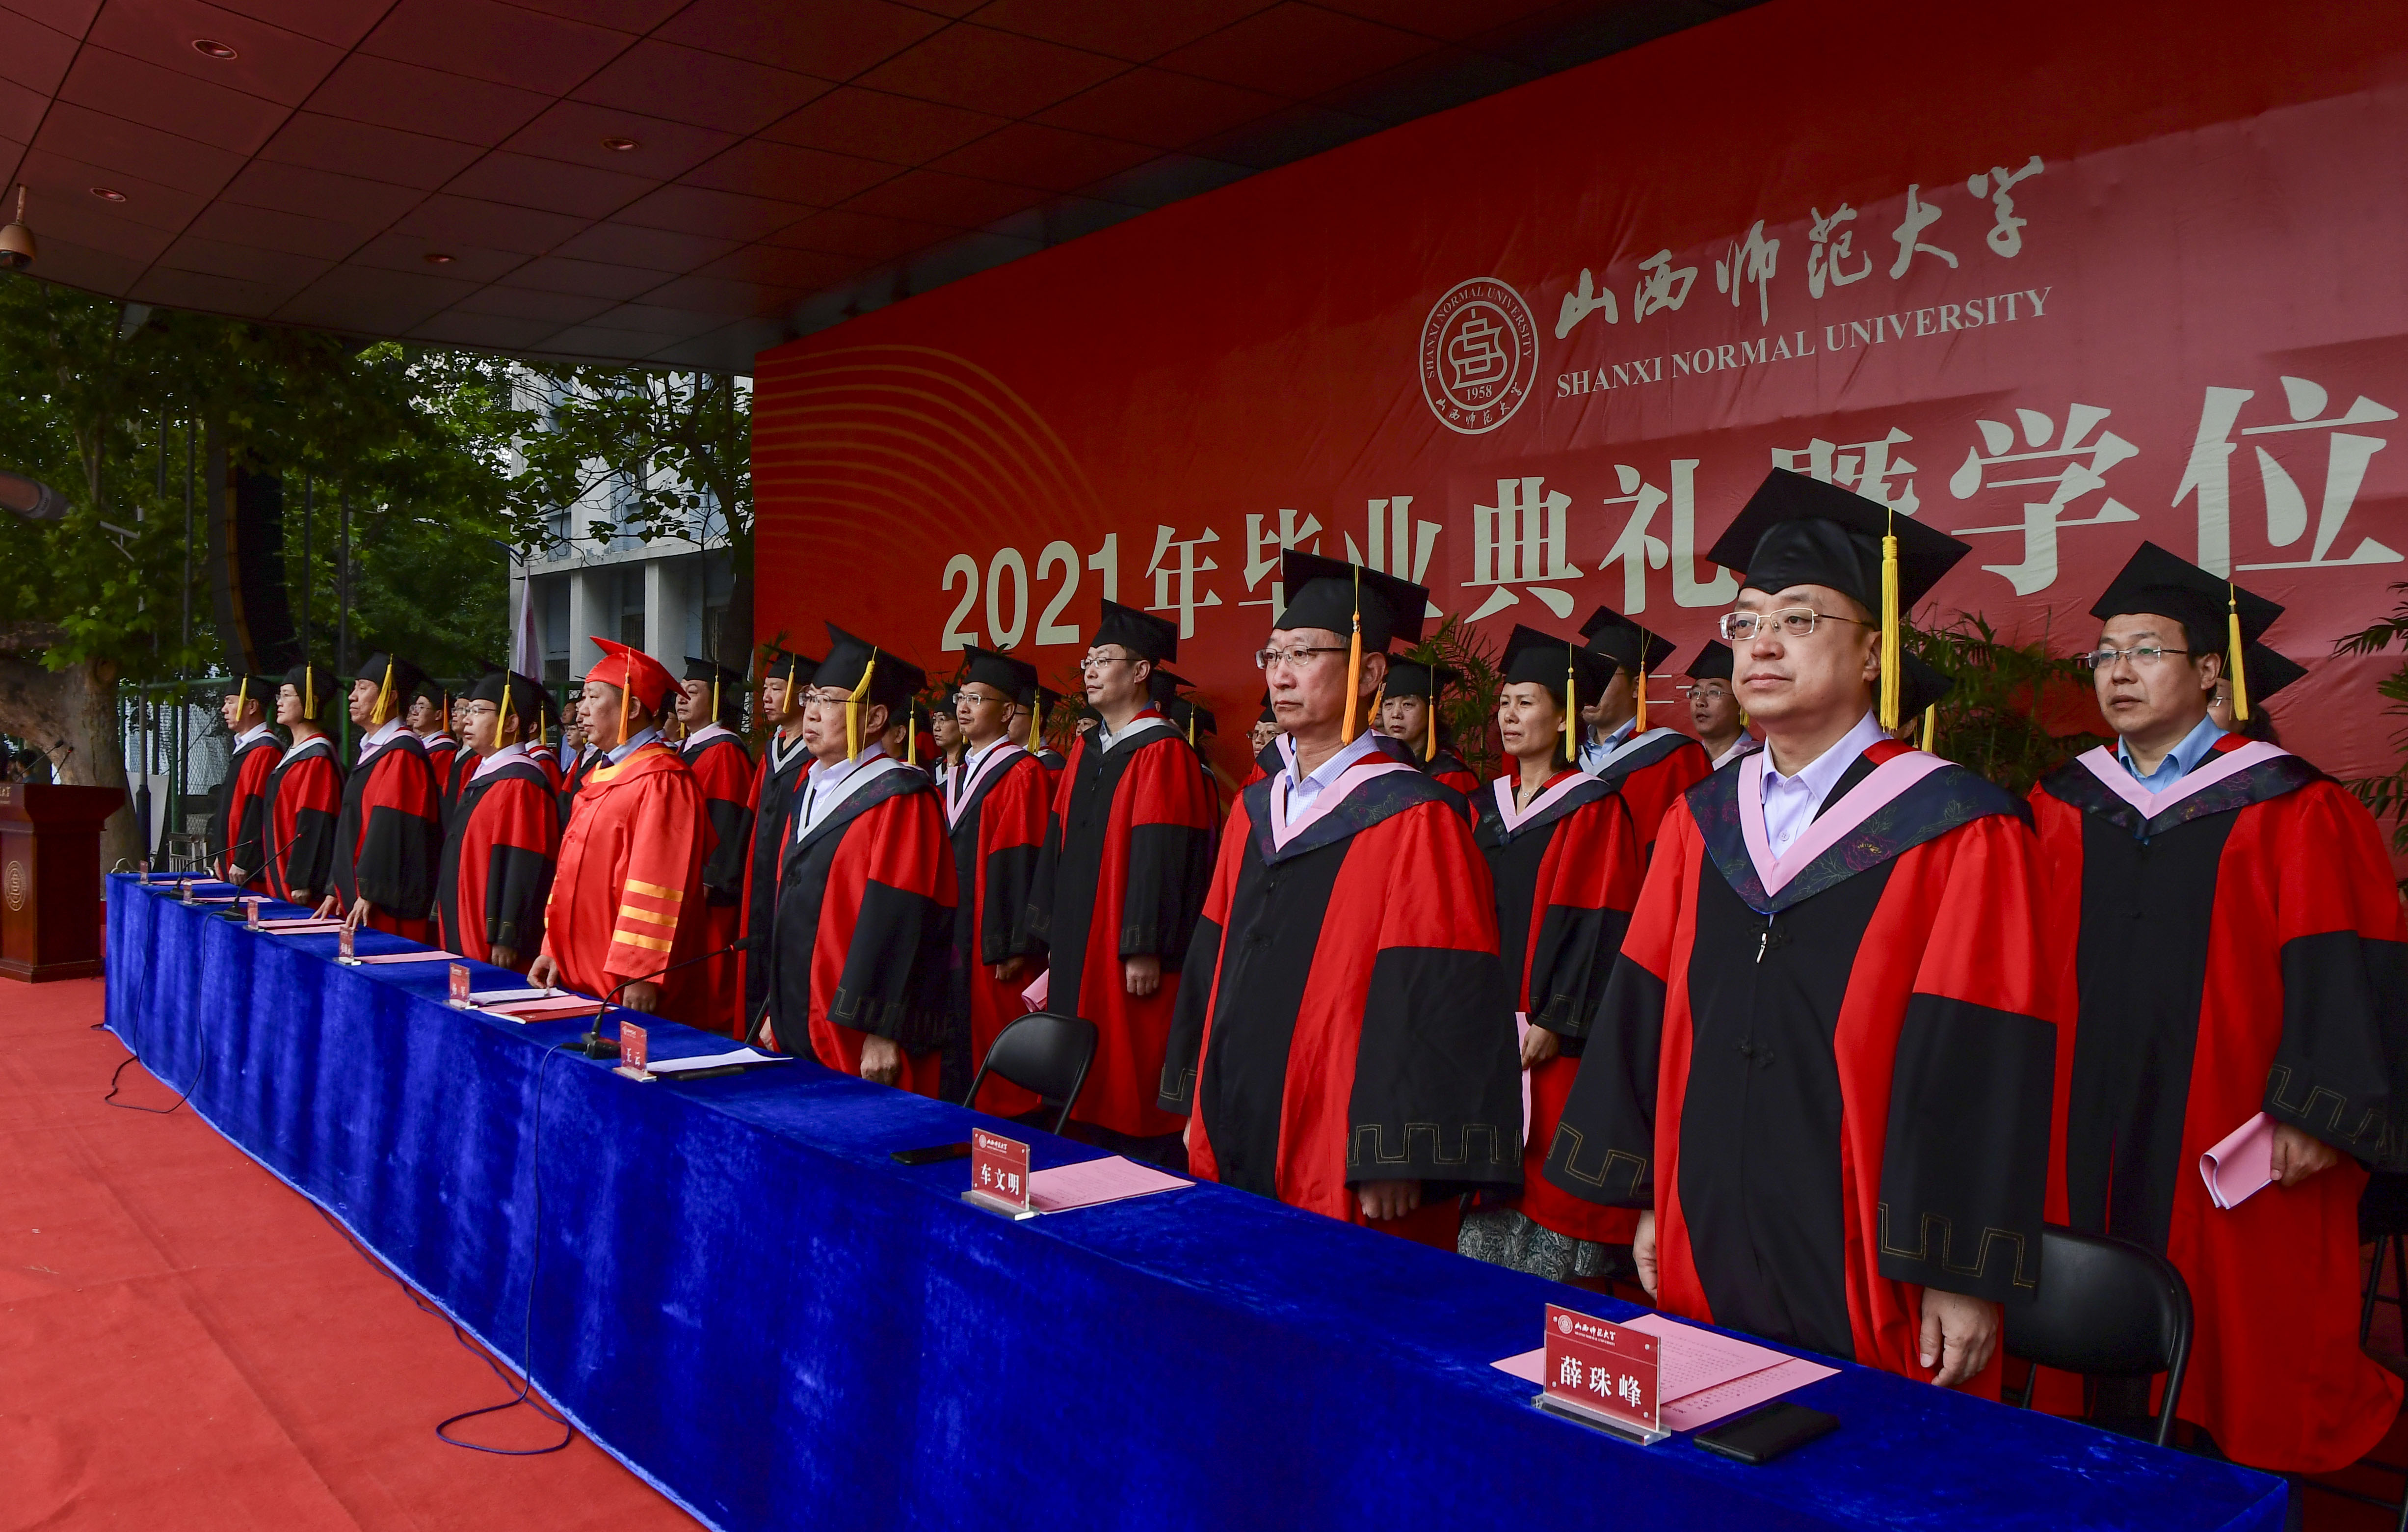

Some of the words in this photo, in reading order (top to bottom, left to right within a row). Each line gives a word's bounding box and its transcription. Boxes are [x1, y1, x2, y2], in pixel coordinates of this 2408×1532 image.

[1555, 155, 2044, 339] 山西师范大学
[1427, 323, 1440, 379] SHANXI
[1437, 286, 1483, 322] NORMAL
[1487, 287, 1532, 358] UNIVERSITY
[1557, 355, 1663, 398] SHANXI
[1671, 330, 1816, 378] NORMAL
[1825, 286, 2052, 351] UNIVERSITY
[1466, 384, 1492, 401] 1958
[980, 1163, 1019, 1195] 车文明
[1561, 1355, 1641, 1407] 薛珠峰
